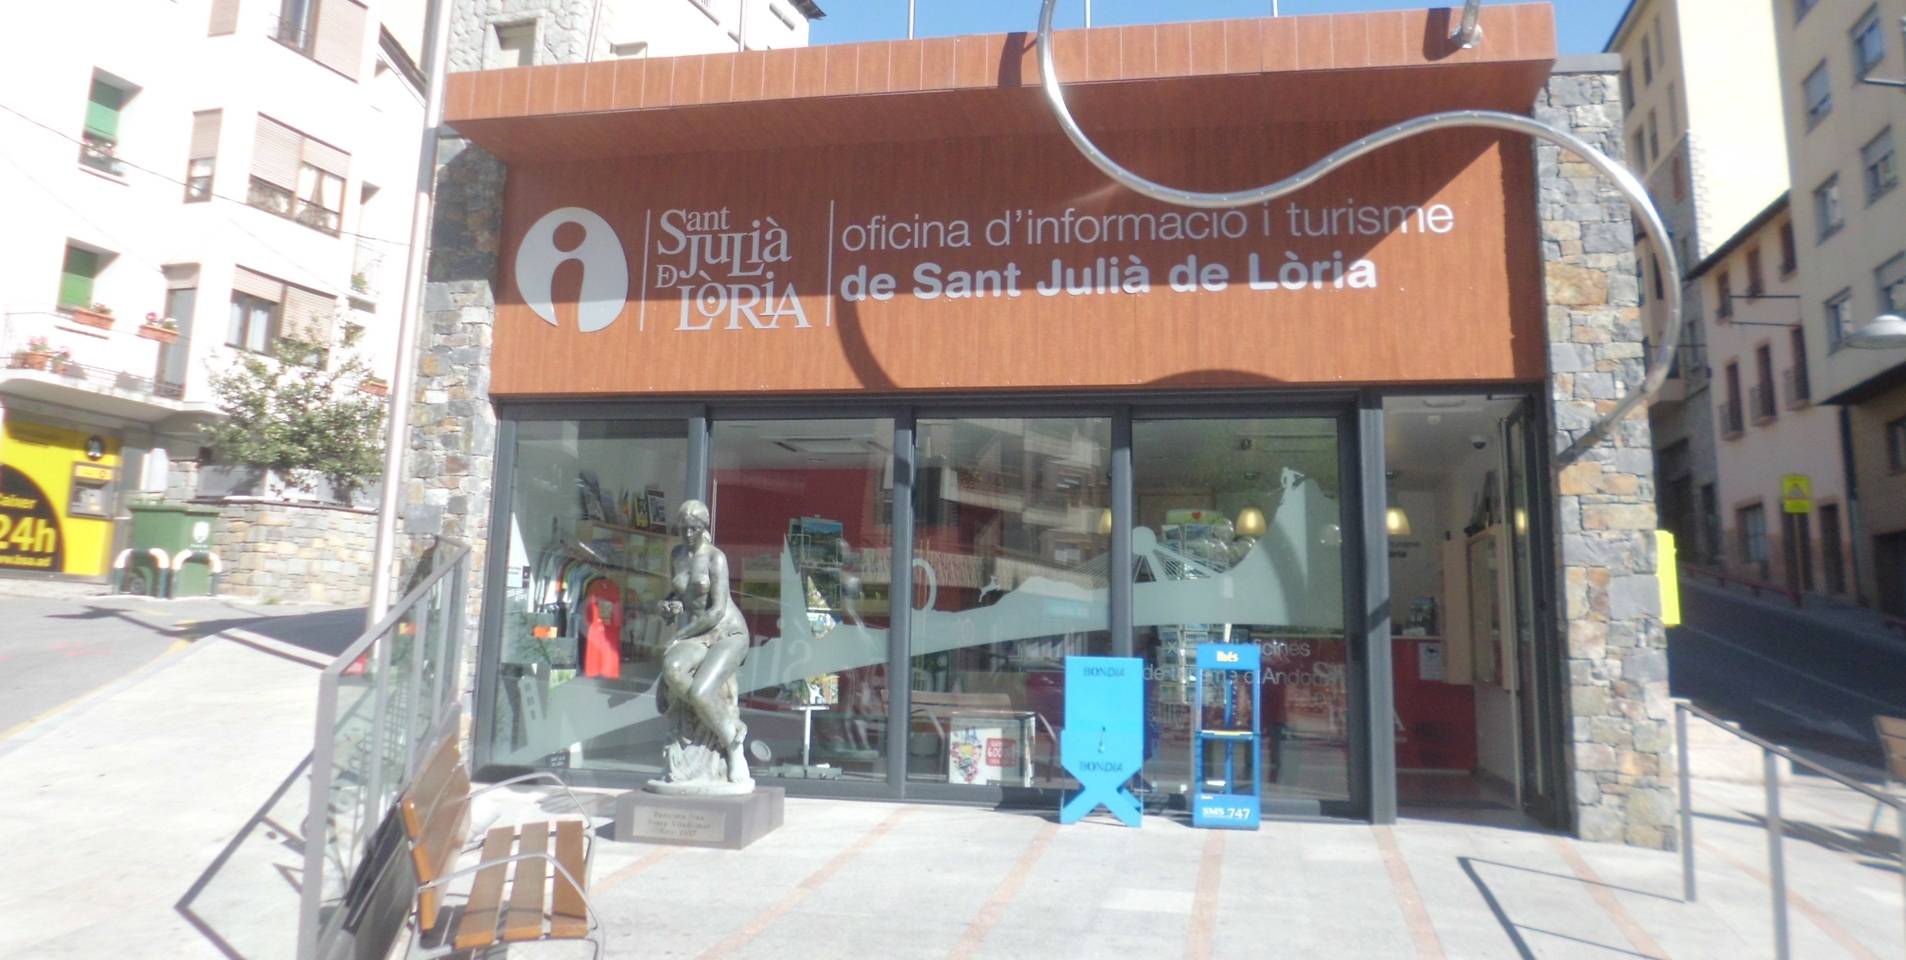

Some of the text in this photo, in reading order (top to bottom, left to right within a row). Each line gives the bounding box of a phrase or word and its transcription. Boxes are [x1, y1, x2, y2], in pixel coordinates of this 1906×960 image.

[657, 206, 731, 255] Sant
[841, 213, 972, 252] oficina
[1263, 200, 1271, 237] i
[1286, 198, 1455, 237] turisme
[840, 249, 1377, 301] de Sant Julià de Lòria
[0, 513, 57, 554] 24h
[1227, 808, 1251, 820] 747
